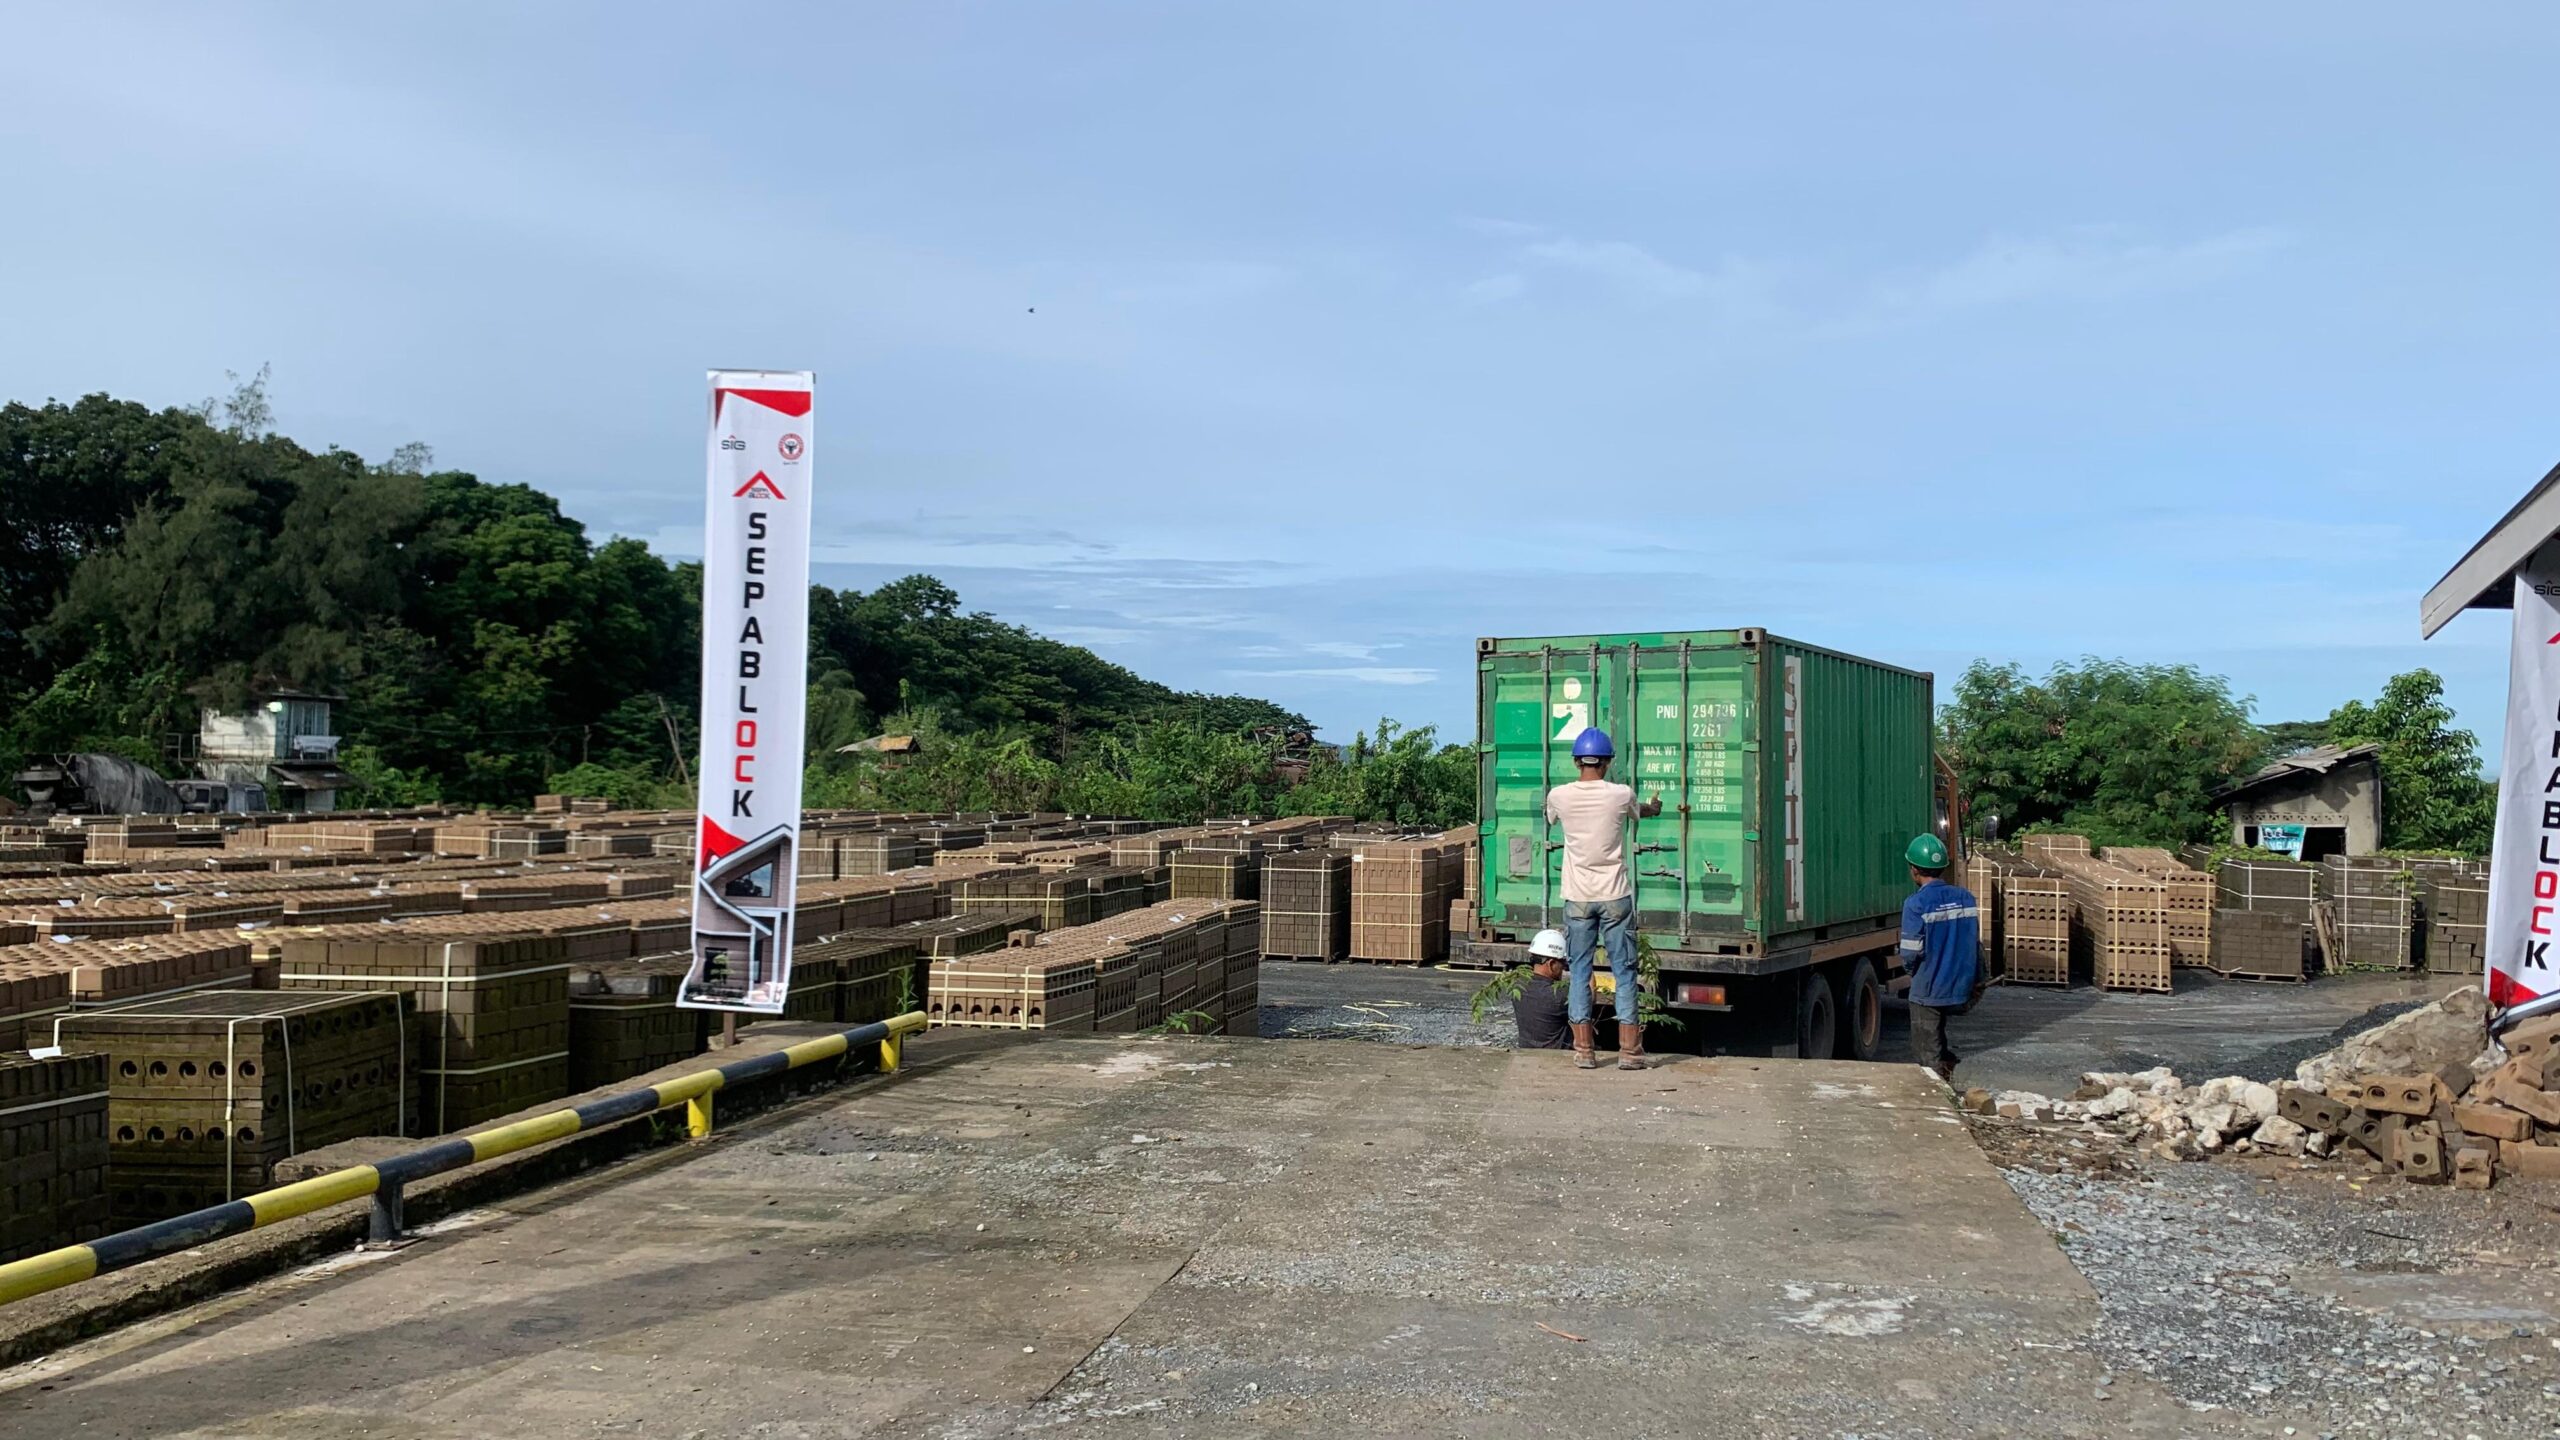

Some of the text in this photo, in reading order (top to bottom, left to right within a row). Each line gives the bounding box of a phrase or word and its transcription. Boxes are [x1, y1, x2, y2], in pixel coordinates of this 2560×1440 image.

[721, 437, 746, 451] SIG
[731, 512, 767, 818] SEPABLOCK
[1656, 705, 1678, 719] PNU
[1692, 723, 1721, 737] 22G1
